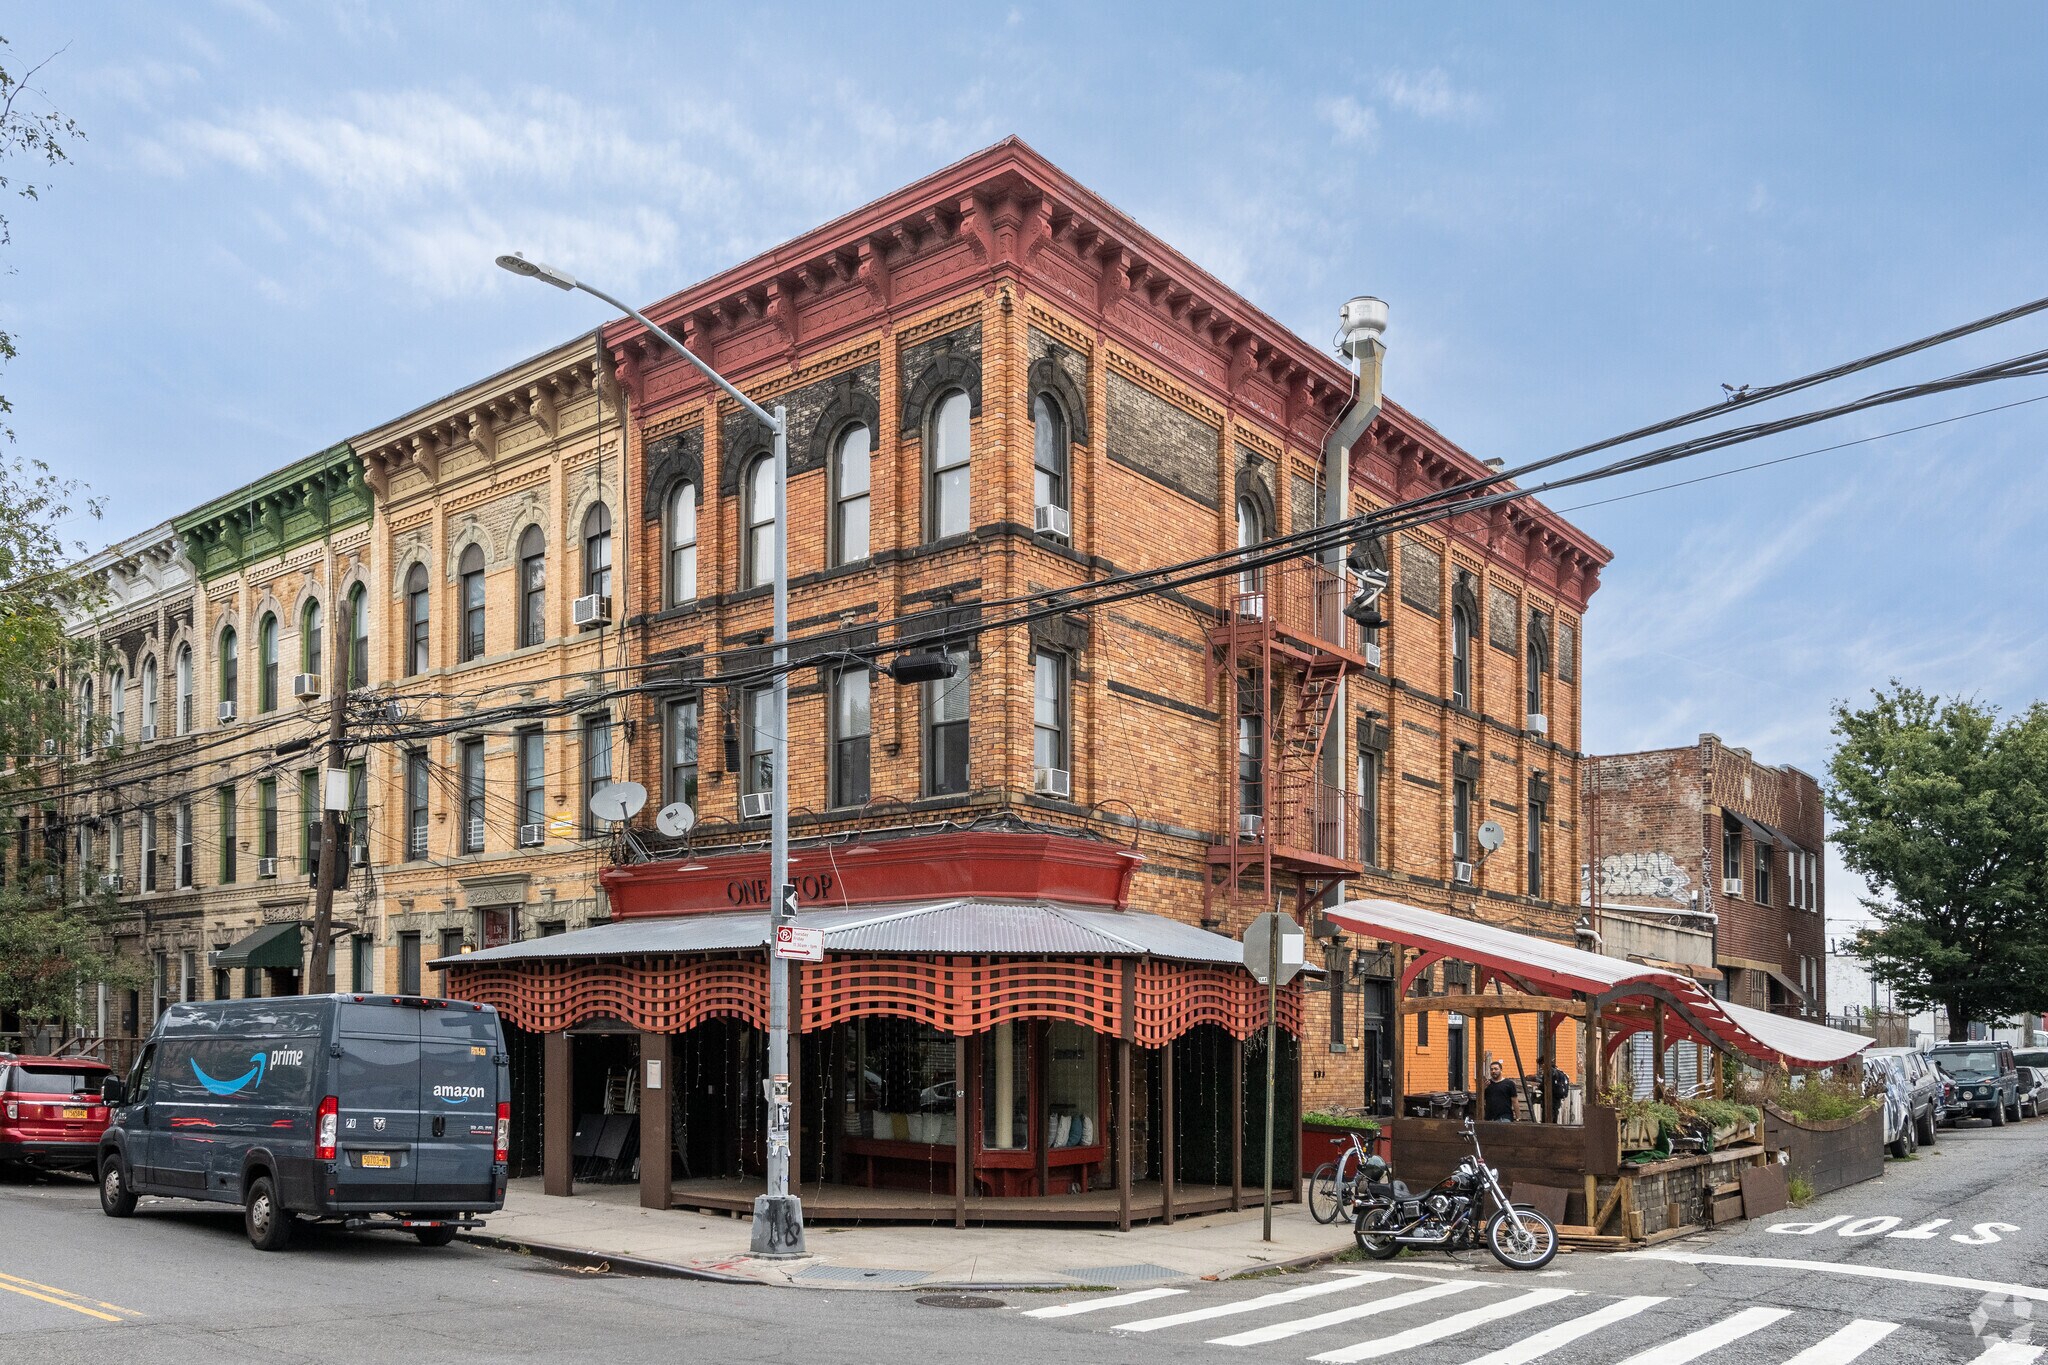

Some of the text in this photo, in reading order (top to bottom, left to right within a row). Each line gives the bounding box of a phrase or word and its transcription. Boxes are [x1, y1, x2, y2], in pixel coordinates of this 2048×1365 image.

[727, 879, 771, 905] ONE
[787, 873, 833, 901] TOP
[270, 1044, 304, 1071] prime
[433, 1085, 485, 1098] amazon
[1765, 1215, 2021, 1244] STOP
